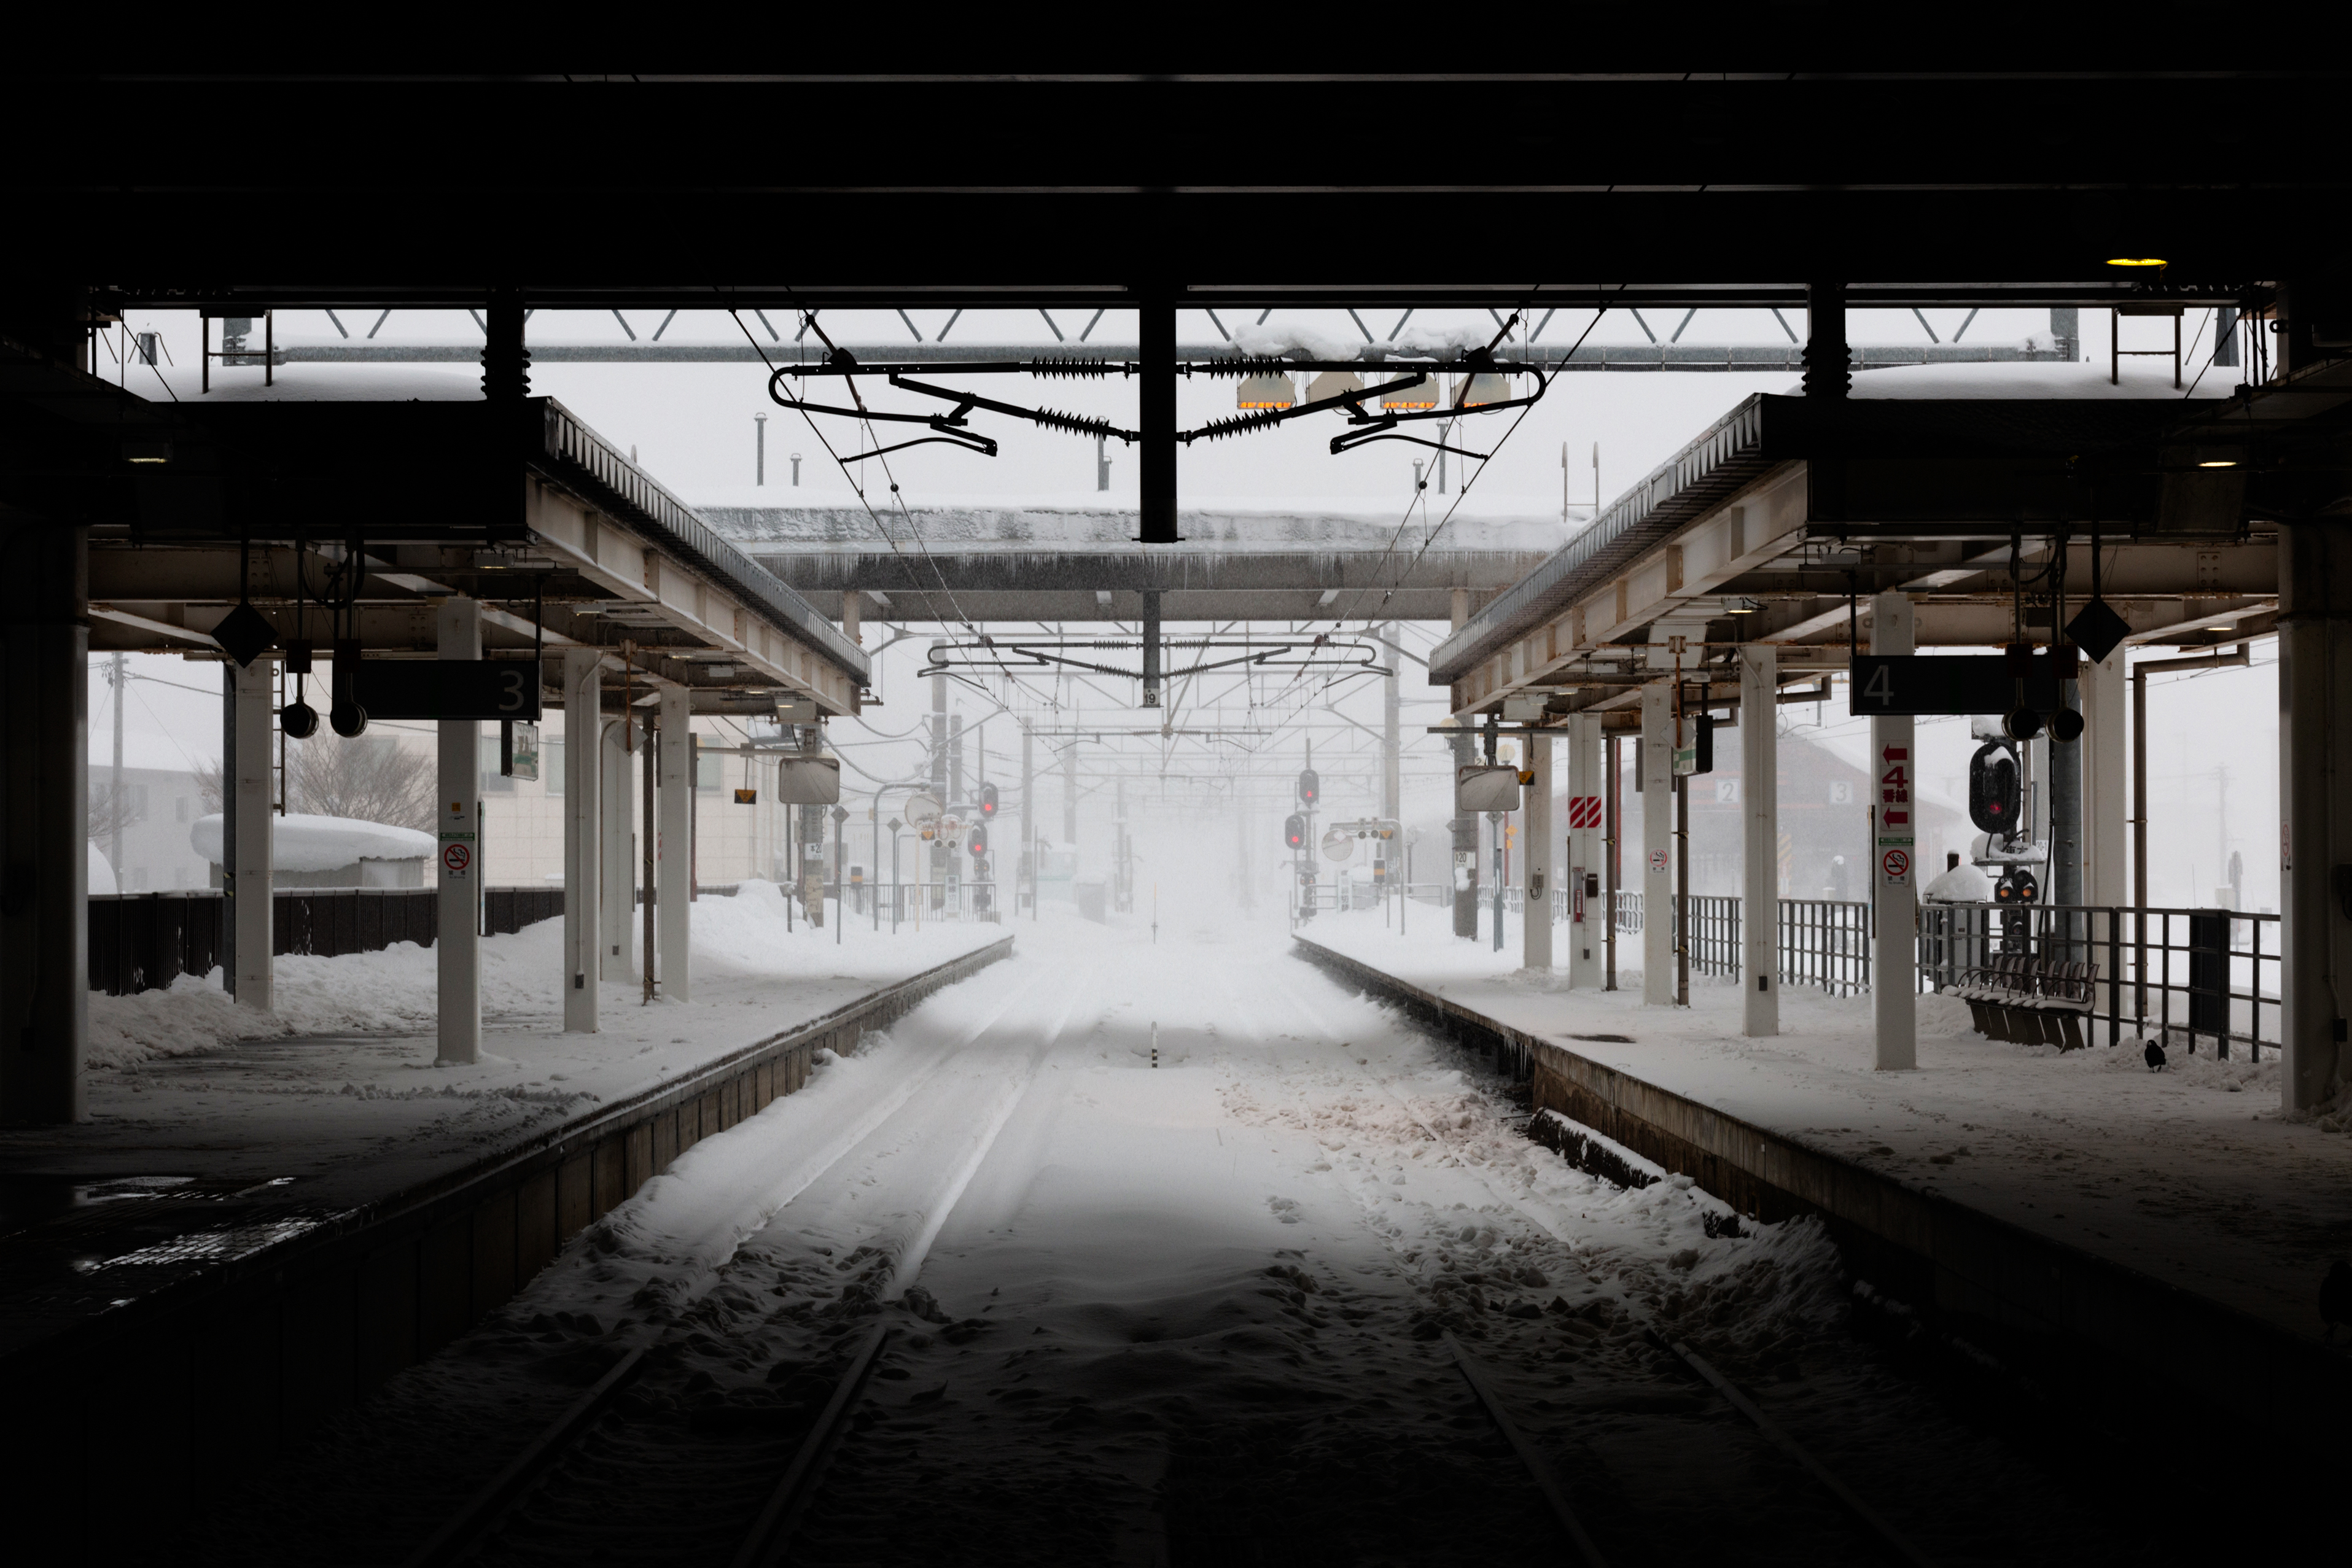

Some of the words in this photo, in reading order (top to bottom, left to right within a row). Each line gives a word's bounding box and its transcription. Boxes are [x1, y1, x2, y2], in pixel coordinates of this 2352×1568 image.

[498, 670, 525, 712] 3
[1863, 664, 1894, 706] 4
[1144, 694, 1156, 704] 19
[1882, 766, 1908, 788] 4
[1722, 783, 1734, 801] 2
[1836, 783, 1847, 802] 3
[1882, 789, 1908, 803] 番線
